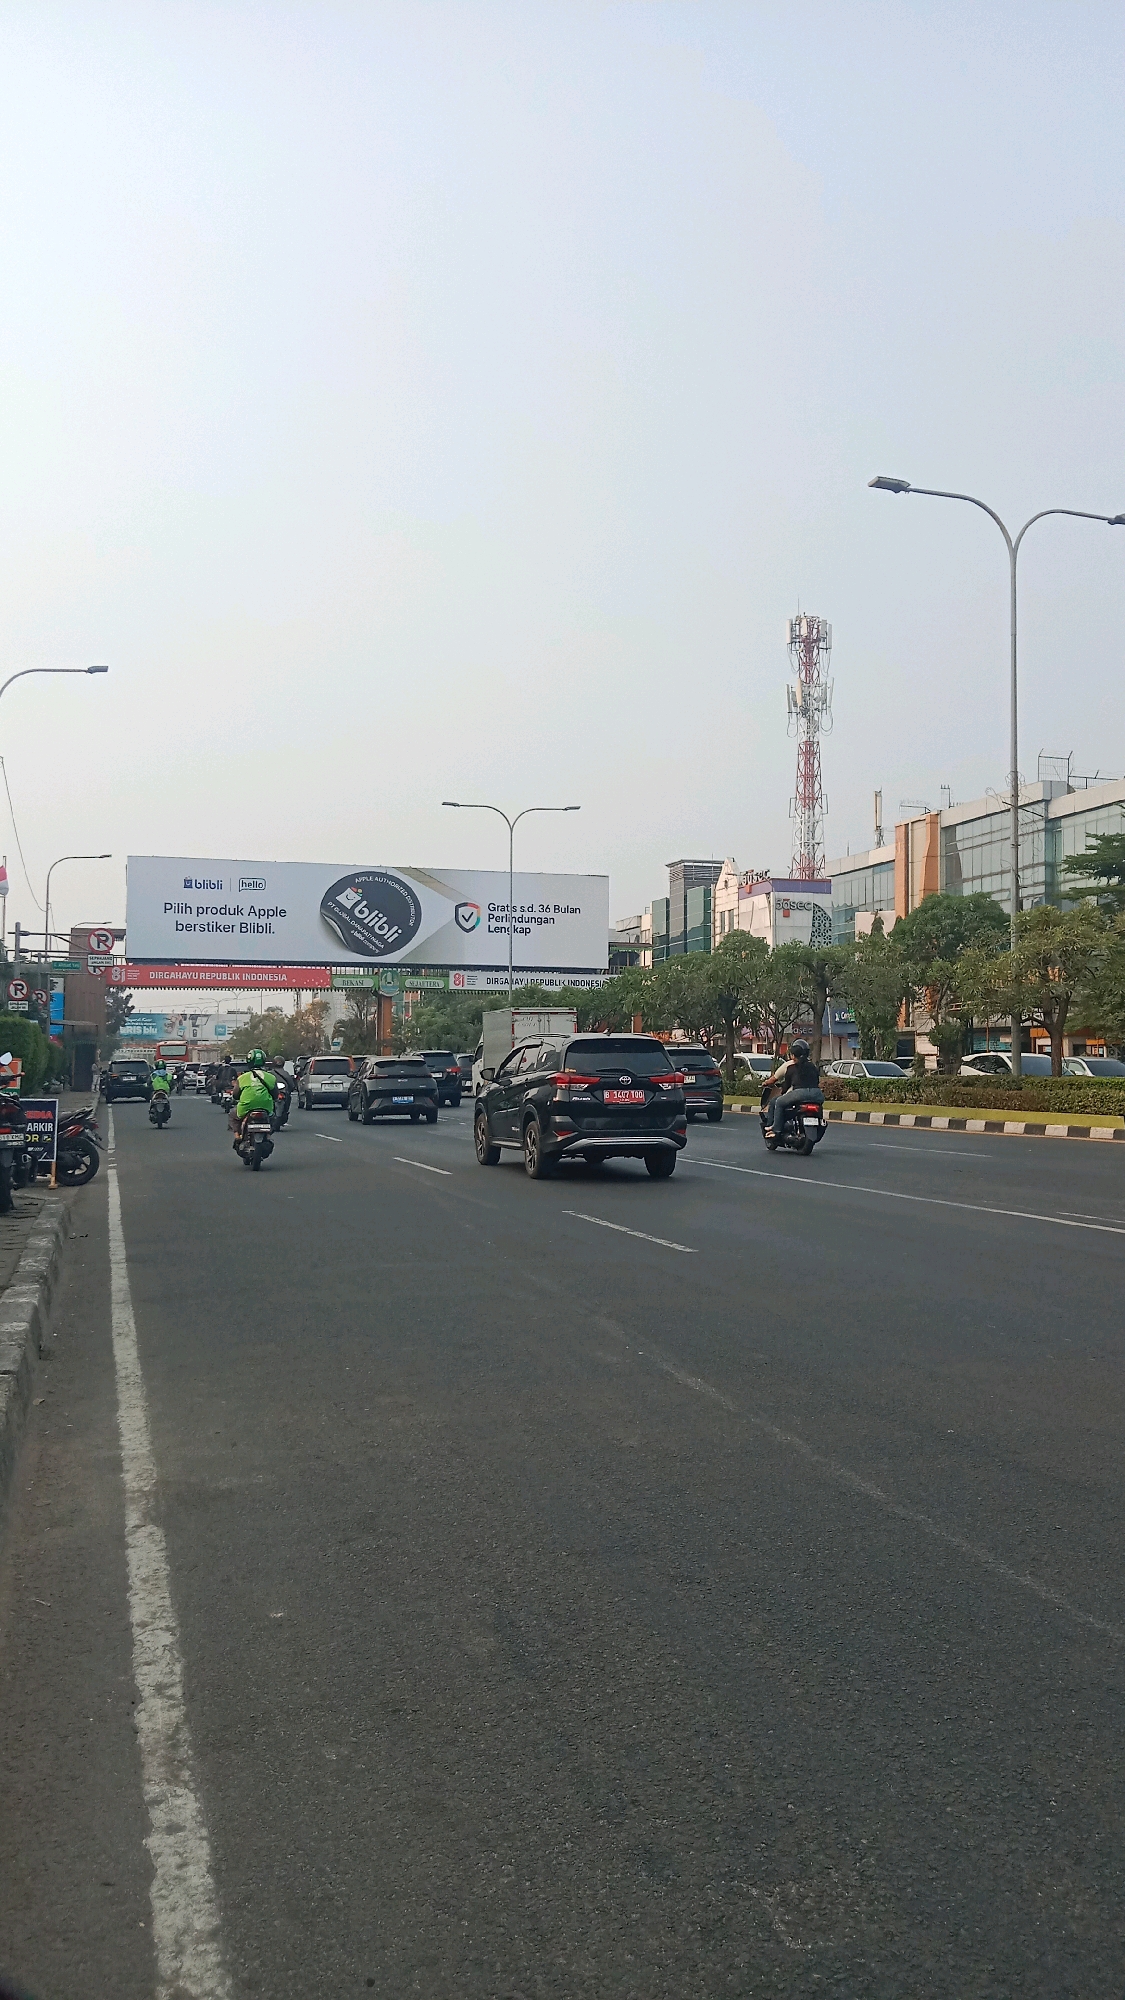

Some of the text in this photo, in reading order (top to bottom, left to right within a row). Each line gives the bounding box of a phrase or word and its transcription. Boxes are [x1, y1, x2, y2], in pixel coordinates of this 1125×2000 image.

[194, 879, 264, 890] blibli hello
[374, 876, 408, 896] AUTHORIZED
[406, 895, 416, 926] DISTRIBUTOR
[164, 902, 287, 920] Pilih produk Apple
[487, 902, 518, 913] Grats
[538, 904, 550, 914] 36
[554, 904, 581, 914] Bulan
[354, 900, 402, 943] blibli
[488, 914, 555, 926] Perlindungan
[175, 920, 275, 934] berstiker Blibli.
[150, 972, 198, 980] DIRGAHAYU
[200, 972, 240, 980] REPUBLIK
[242, 972, 287, 981] INDONESIA
[26, 1122, 54, 1132] ARKIR
